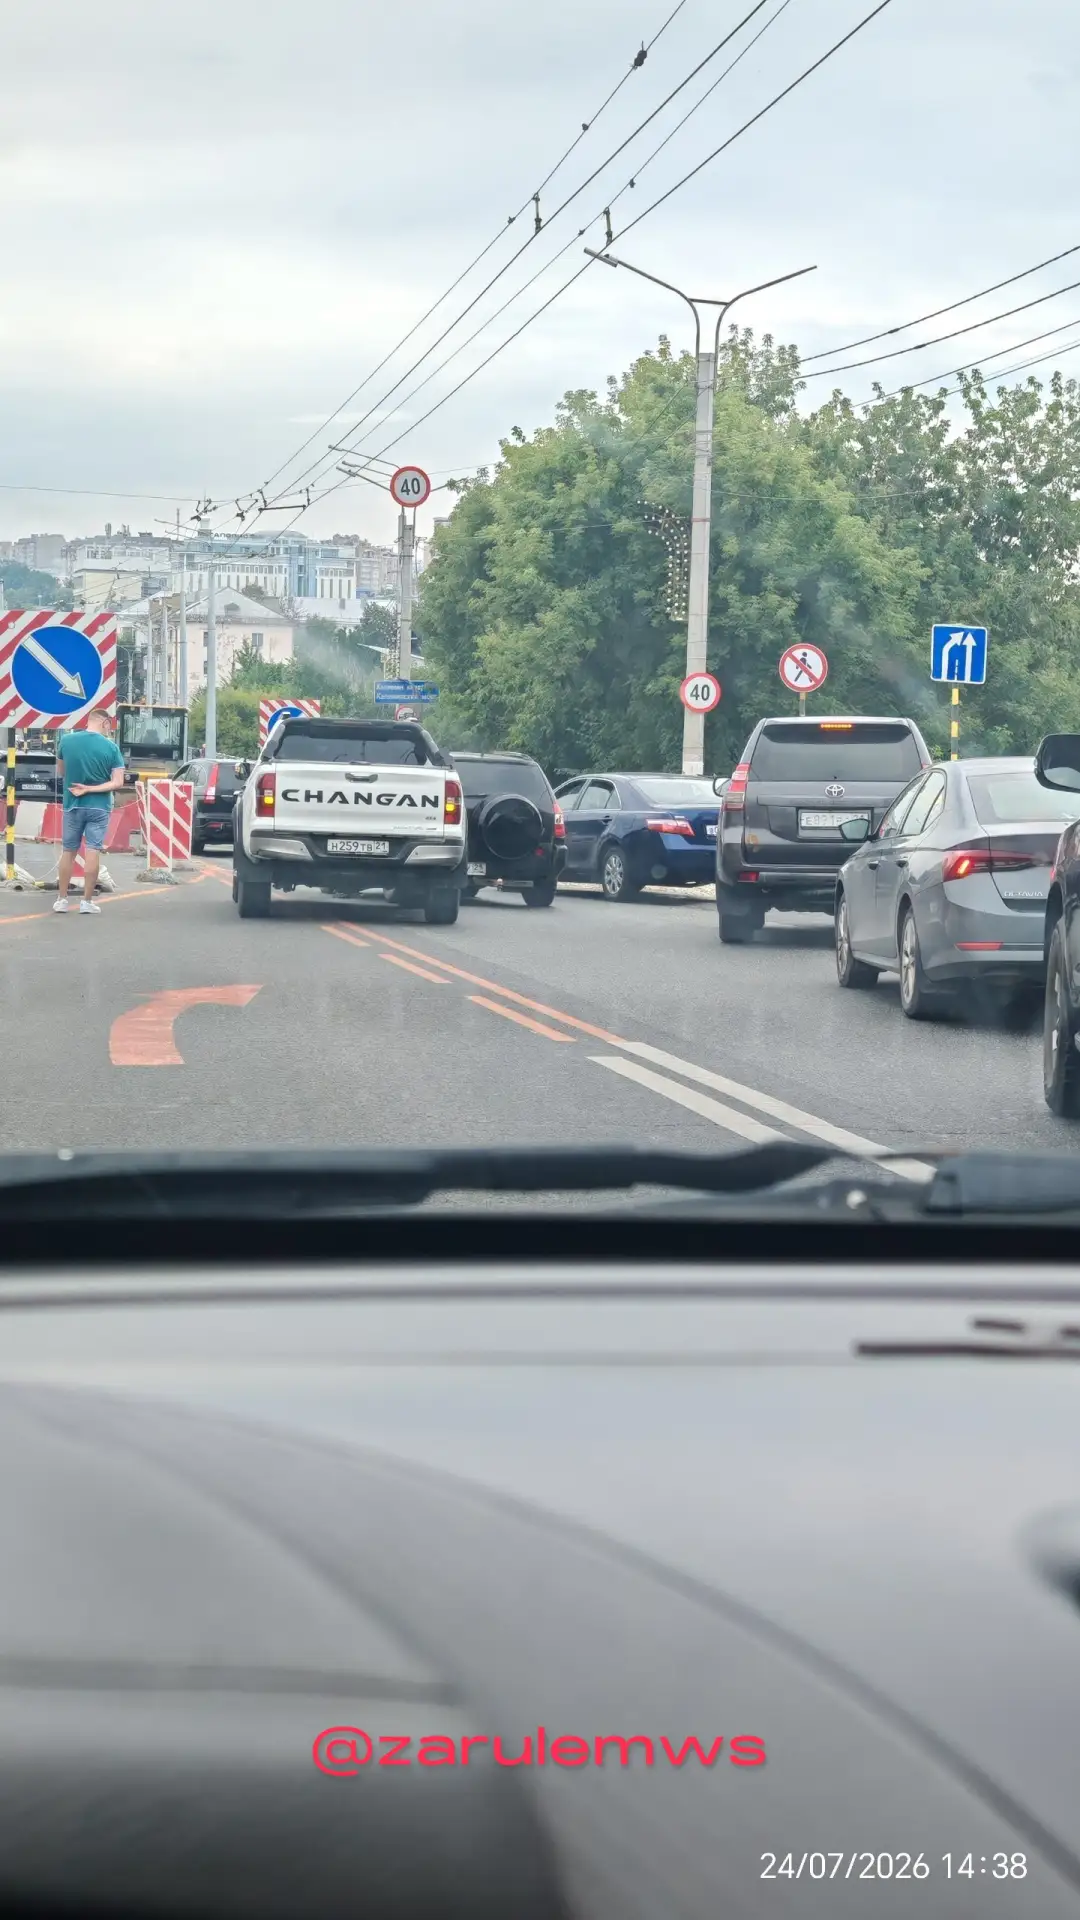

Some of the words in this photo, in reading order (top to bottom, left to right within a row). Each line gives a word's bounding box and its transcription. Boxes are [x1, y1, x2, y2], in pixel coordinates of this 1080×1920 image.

[401, 478, 420, 495] 40
[690, 684, 710, 701] 40
[281, 789, 439, 808] CHANGAN
[375, 841, 387, 850] 21
